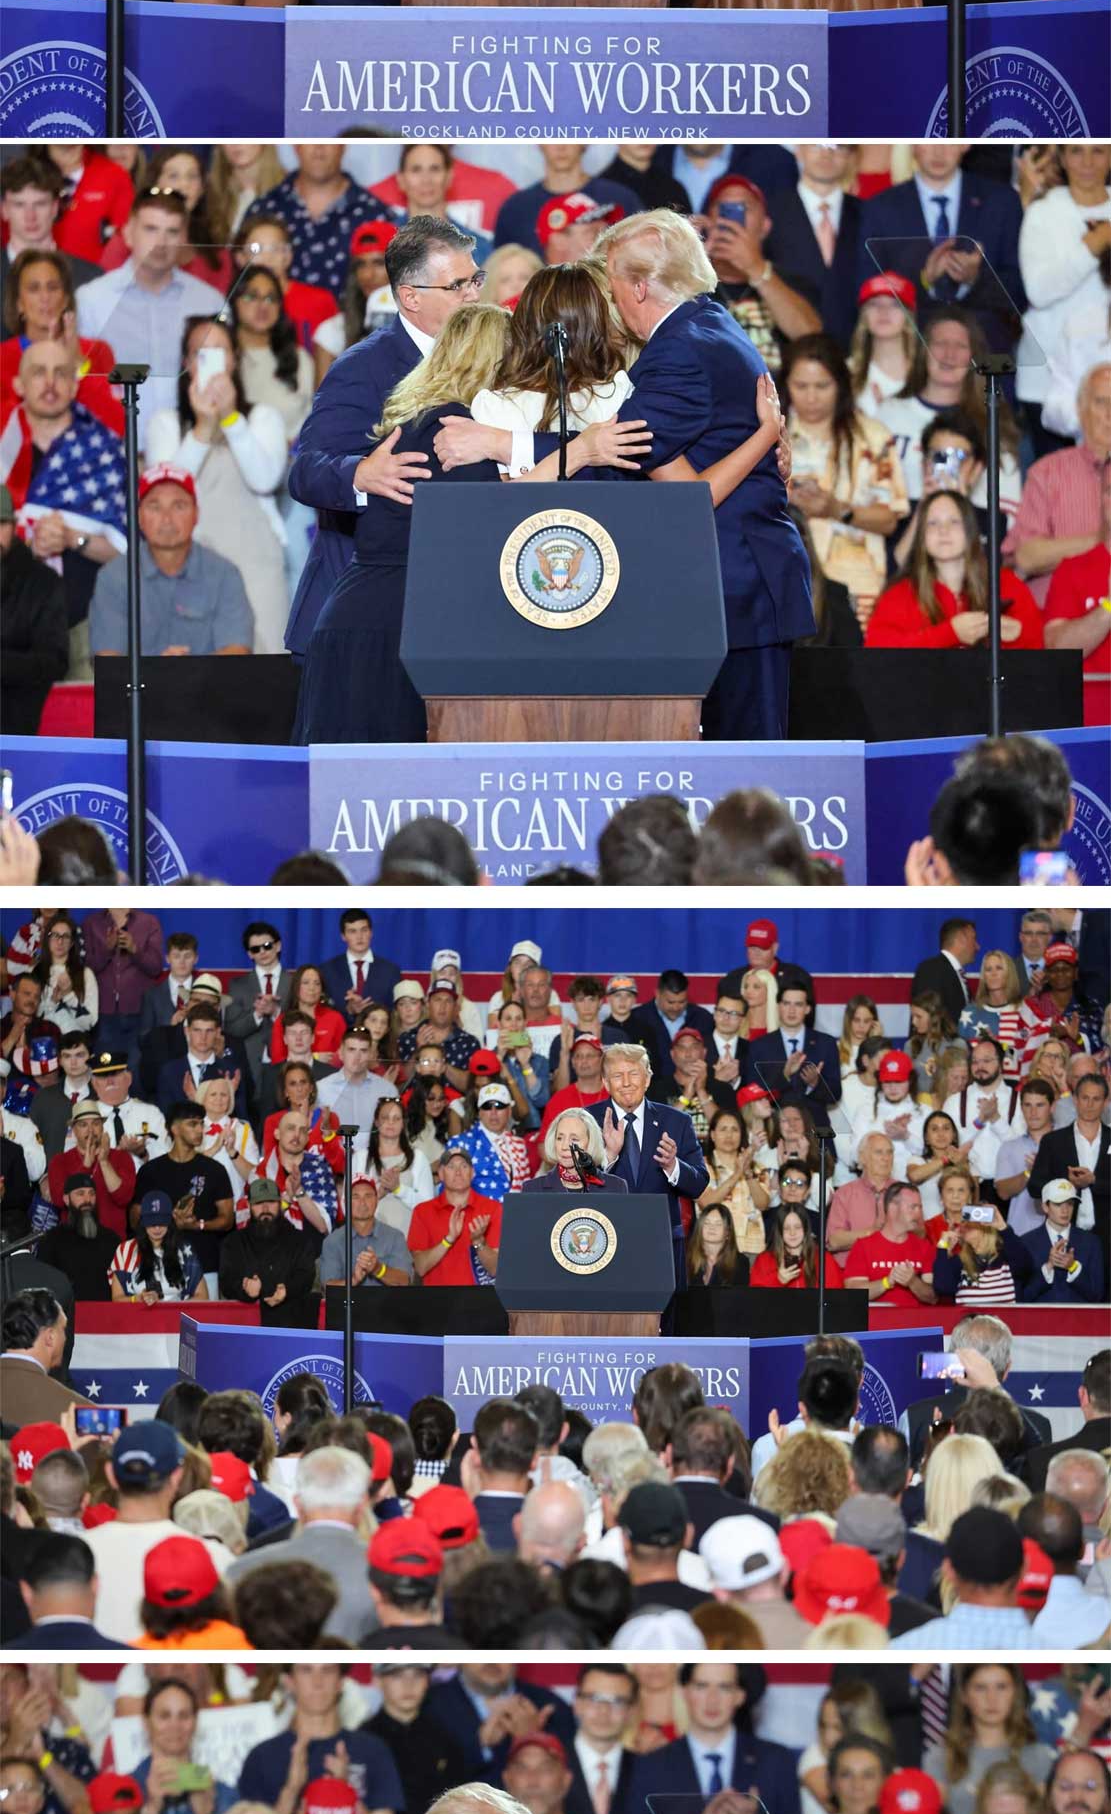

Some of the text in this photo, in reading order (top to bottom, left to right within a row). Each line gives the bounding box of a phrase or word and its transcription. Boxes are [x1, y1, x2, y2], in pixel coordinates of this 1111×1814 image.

[452, 36, 662, 56] FIGHTING FOR
[68, 56, 89, 71] OF
[1008, 60, 1024, 75] OF
[1026, 65, 1051, 92] THE
[301, 60, 812, 116] AMERICAN WORKERS
[401, 125, 507, 138] ROCKLAND
[607, 126, 651, 138] NEW
[659, 126, 710, 138] YORK
[504, 514, 557, 566] PRESIDENT
[591, 528, 616, 576] UNITED
[520, 601, 550, 622] SEAL
[570, 588, 611, 622] STATES
[480, 771, 695, 792] FIGHTING FOR
[88, 798, 110, 814] OF
[322, 1363, 334, 1372] OF
[537, 1353, 656, 1364] FIGHTING FOR
